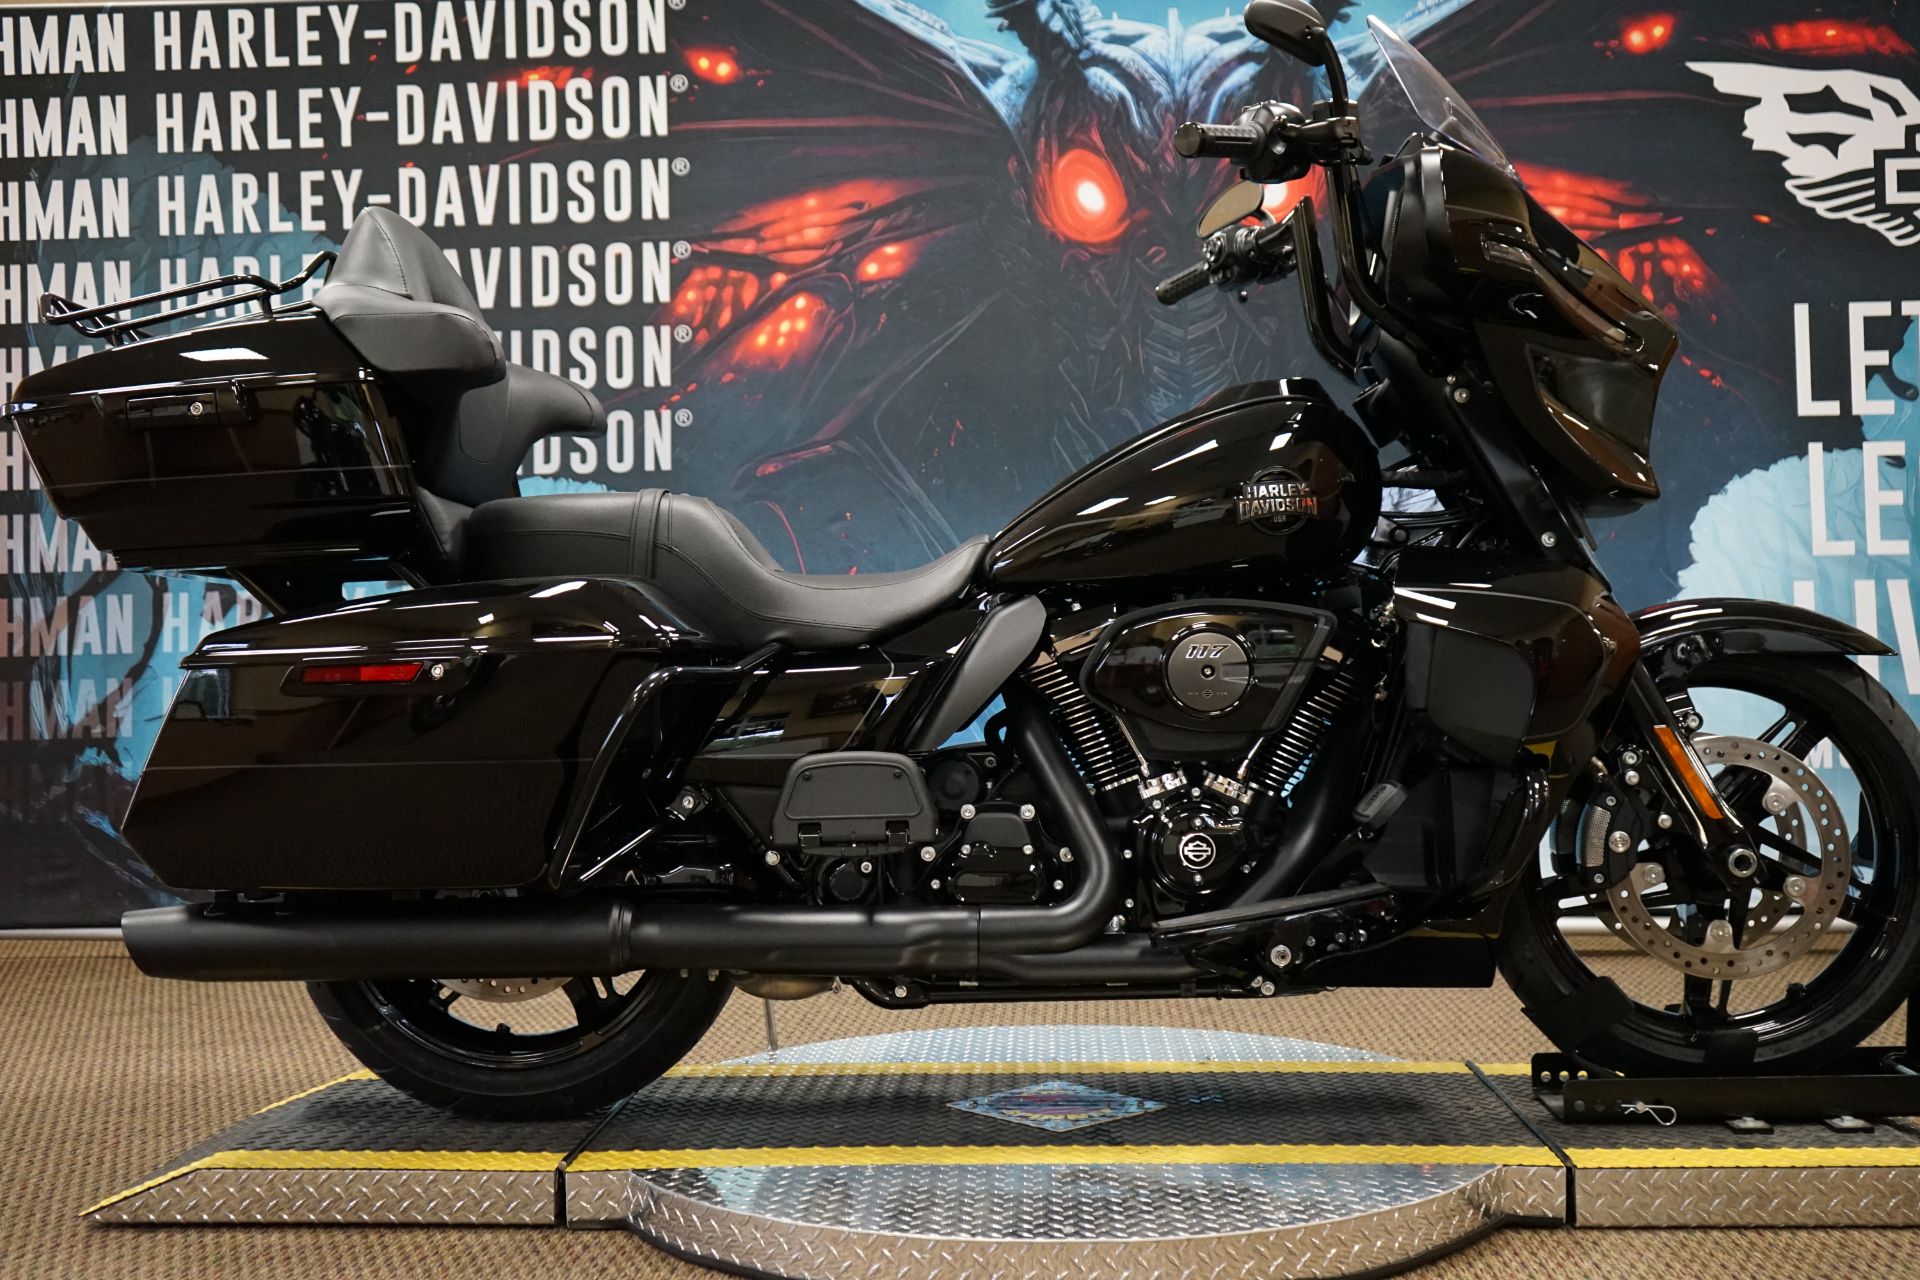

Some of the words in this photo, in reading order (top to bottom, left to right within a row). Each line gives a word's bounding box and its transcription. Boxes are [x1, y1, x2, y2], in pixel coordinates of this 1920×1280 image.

[0, 13, 125, 75] HMAN
[0, 95, 128, 158] HMAN
[0, 177, 130, 241] HMAN
[0, 260, 131, 324] HMAN
[1239, 497, 1318, 520] DAVIDSON
[0, 513, 118, 574] HMA
[0, 593, 133, 657] HMAN
[1185, 643, 1231, 659] 117
